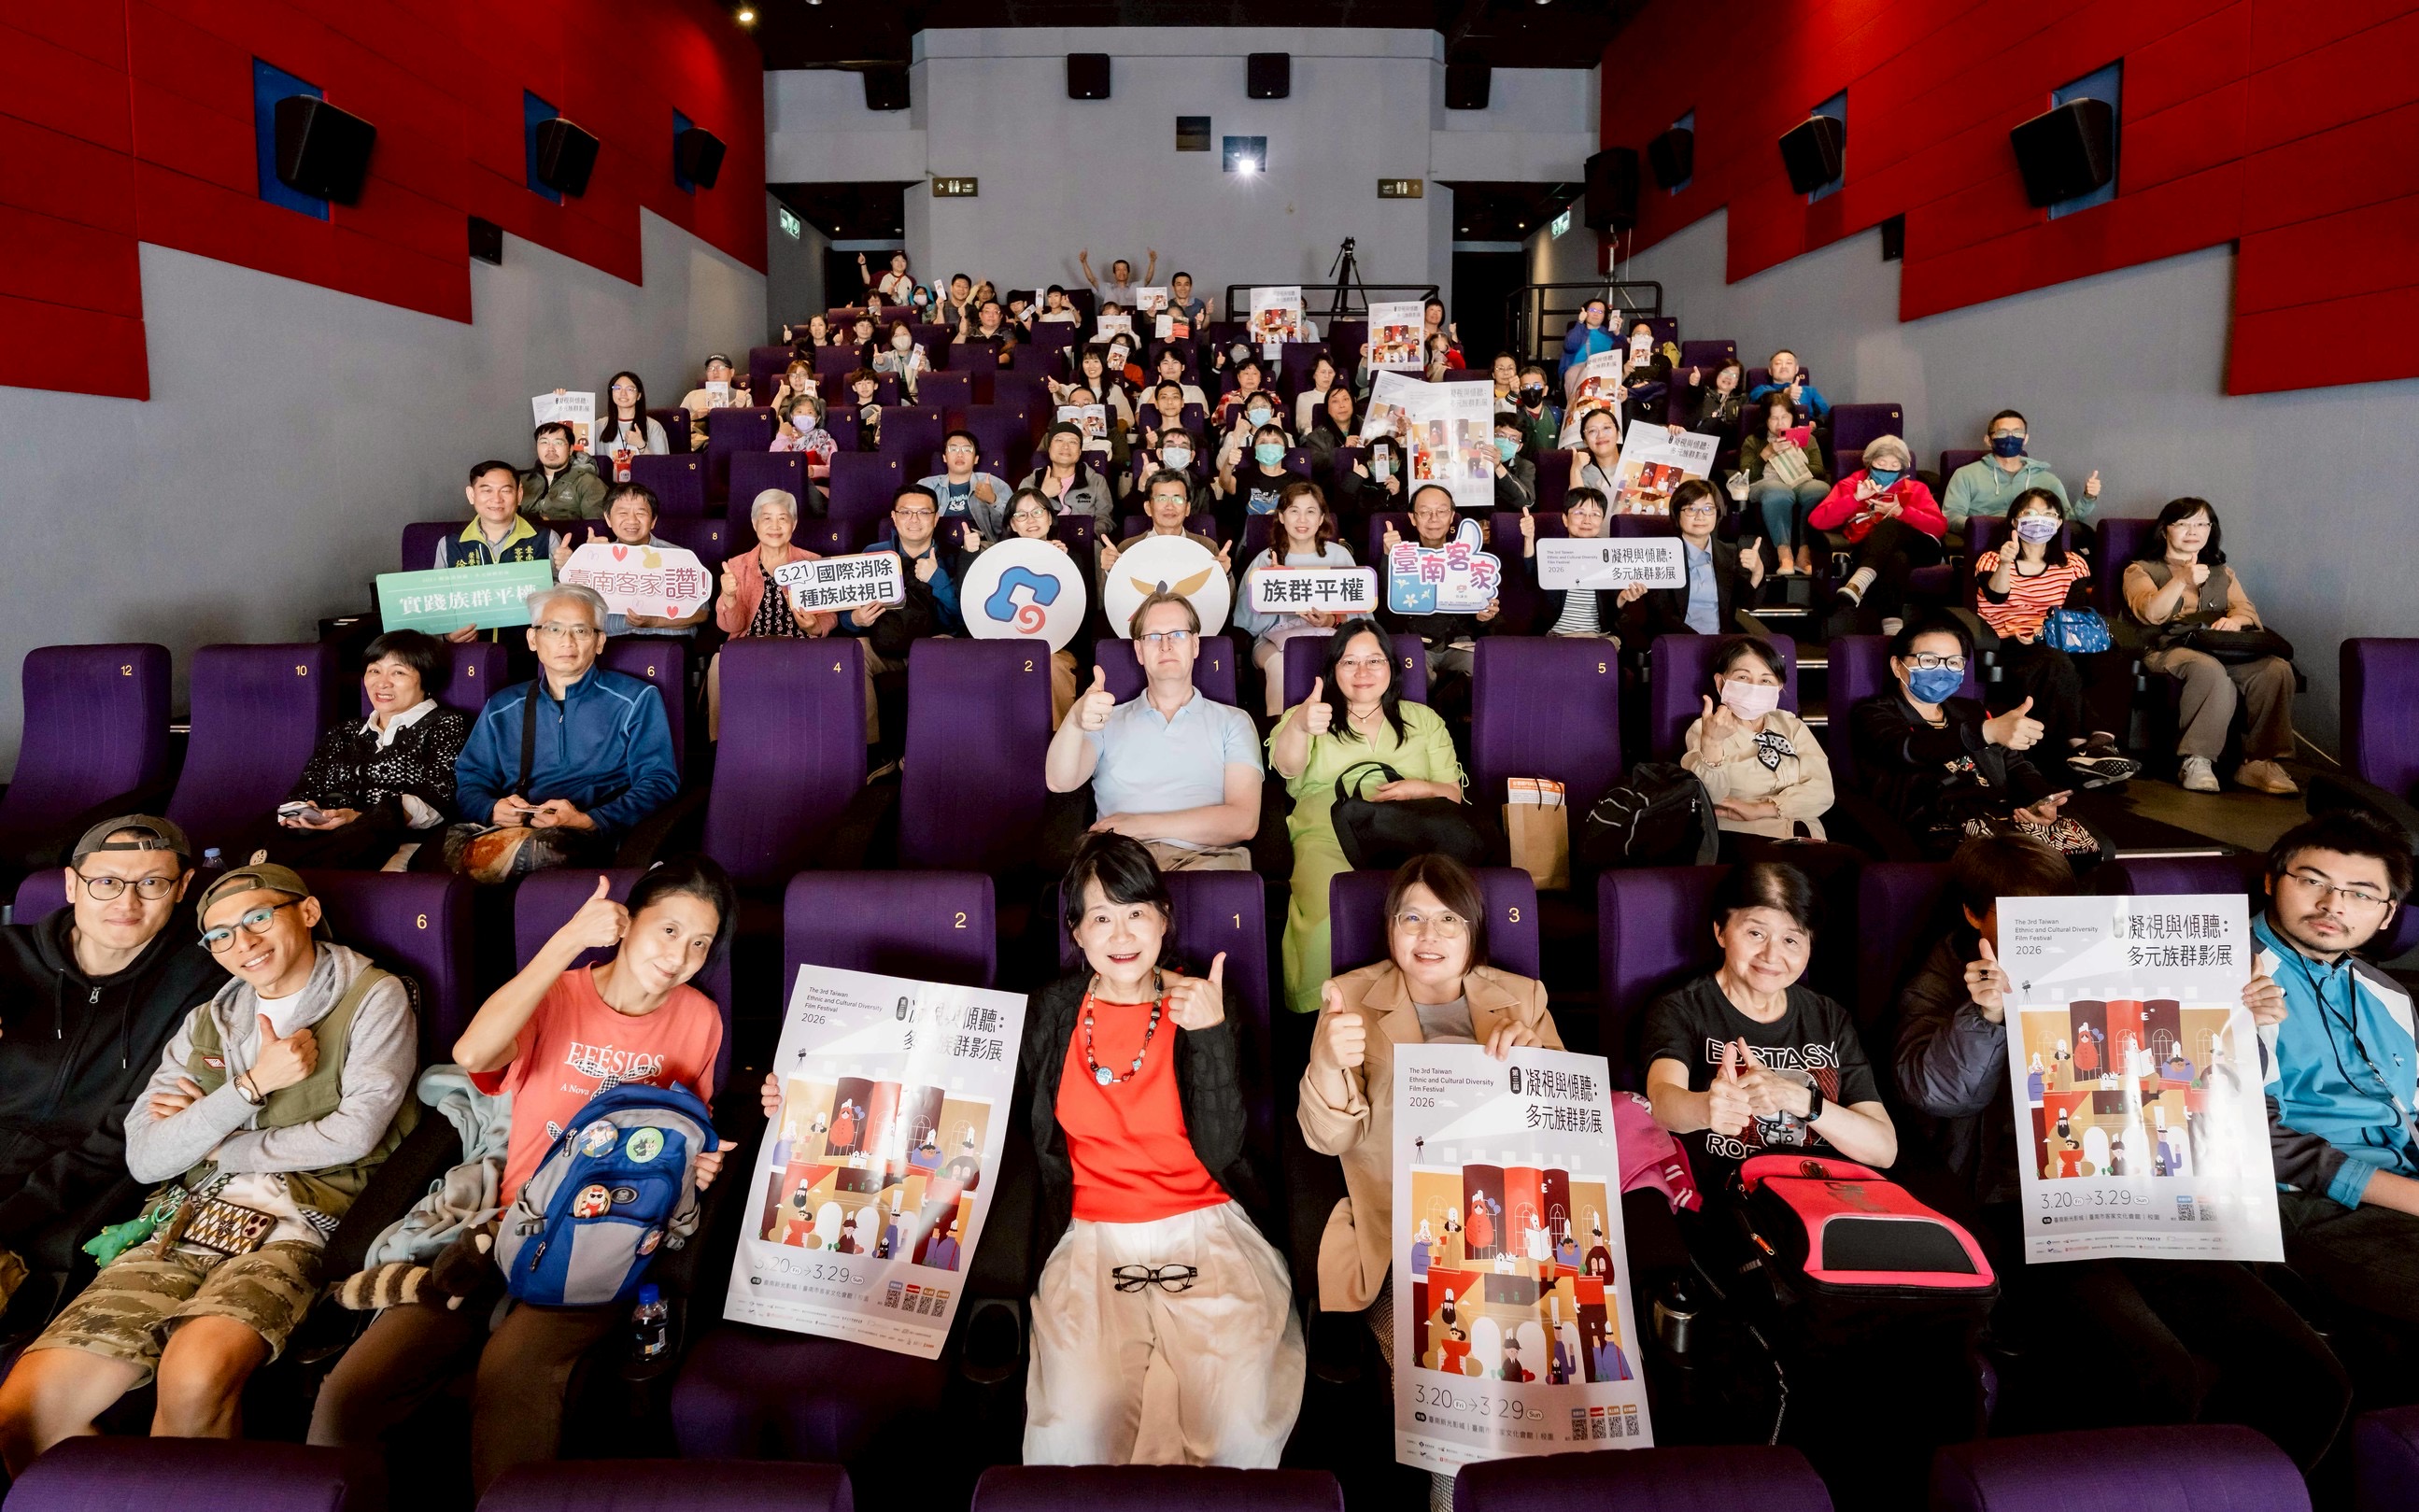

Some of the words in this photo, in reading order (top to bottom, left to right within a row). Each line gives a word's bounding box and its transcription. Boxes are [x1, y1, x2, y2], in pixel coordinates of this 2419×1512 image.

[688, 462, 697, 471] 10
[789, 459, 796, 468] 8
[712, 531, 718, 541] 8
[952, 529, 958, 538] 4
[1077, 527, 1084, 536] 2
[1201, 528, 1208, 536] 1
[1449, 526, 1457, 534] 5
[831, 532, 838, 542] 6
[779, 564, 809, 583] 3.21
[816, 558, 893, 583] 國際消除
[1393, 542, 1495, 590] 臺南客家
[1612, 566, 1676, 581] 多元族群影展
[799, 580, 894, 608] 種族歧視日
[1263, 577, 1365, 602] 族群平權
[832, 661, 842, 673] 4
[1024, 659, 1033, 672] 2
[1213, 659, 1219, 672] 1
[1405, 657, 1413, 669] 3
[1598, 662, 1606, 674] 5
[120, 664, 133, 676] 12
[295, 665, 307, 676] 10
[467, 665, 475, 677] 8
[646, 665, 656, 677] 6
[417, 913, 428, 929] 6
[955, 911, 967, 928] 2
[1232, 912, 1240, 929] 1
[1508, 907, 1521, 923] 3
[2072, 926, 2099, 934] Diversity
[2016, 945, 2043, 955] 2026
[2127, 944, 2233, 968] 多元族群影展
[816, 1004, 839, 1012] Festival
[835, 998, 857, 1008] Cultural
[857, 1002, 883, 1011] Diversity
[801, 1013, 826, 1024] 2026
[564, 1041, 665, 1077] EFÉSIOS
[568, 1084, 589, 1095] Nova
[1409, 1097, 1435, 1108] 2026
[1526, 1104, 1604, 1134] 多元族群影展
[2041, 1192, 2072, 1209] 3.20
[2094, 1189, 2131, 1206] 3.29
[813, 1264, 851, 1283] 3.29
[852, 1276, 864, 1284] Sun
[1415, 1384, 1452, 1408] 3.20
[1480, 1396, 1524, 1420] 329
[1528, 1410, 1542, 1419] Sun
